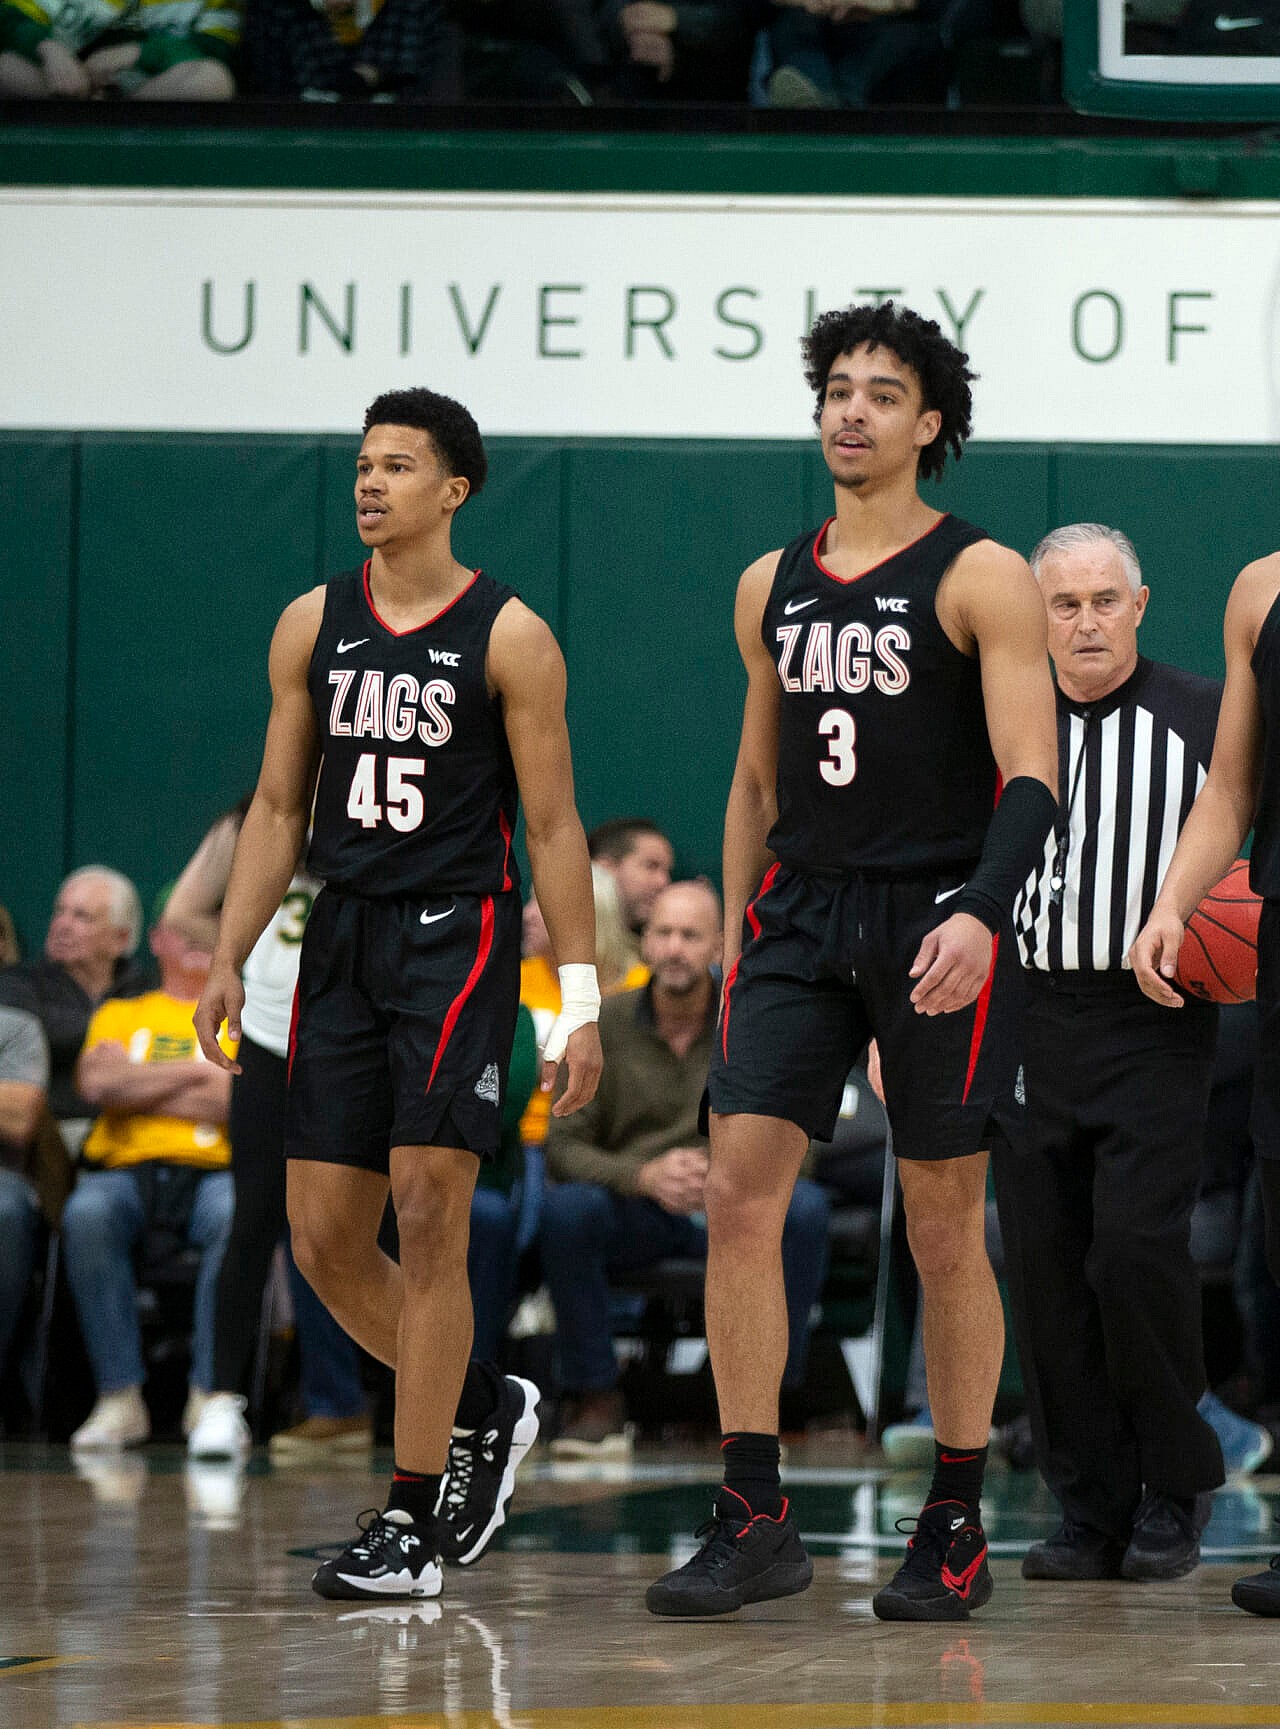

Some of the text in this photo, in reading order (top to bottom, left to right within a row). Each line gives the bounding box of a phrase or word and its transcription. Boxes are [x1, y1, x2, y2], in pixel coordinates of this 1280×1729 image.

[1072, 288, 1216, 364] OF
[428, 648, 462, 667] WCC
[776, 622, 911, 696] ZAGS
[328, 669, 456, 747] ZAGS
[818, 708, 856, 787] 3
[347, 753, 426, 833] 45
